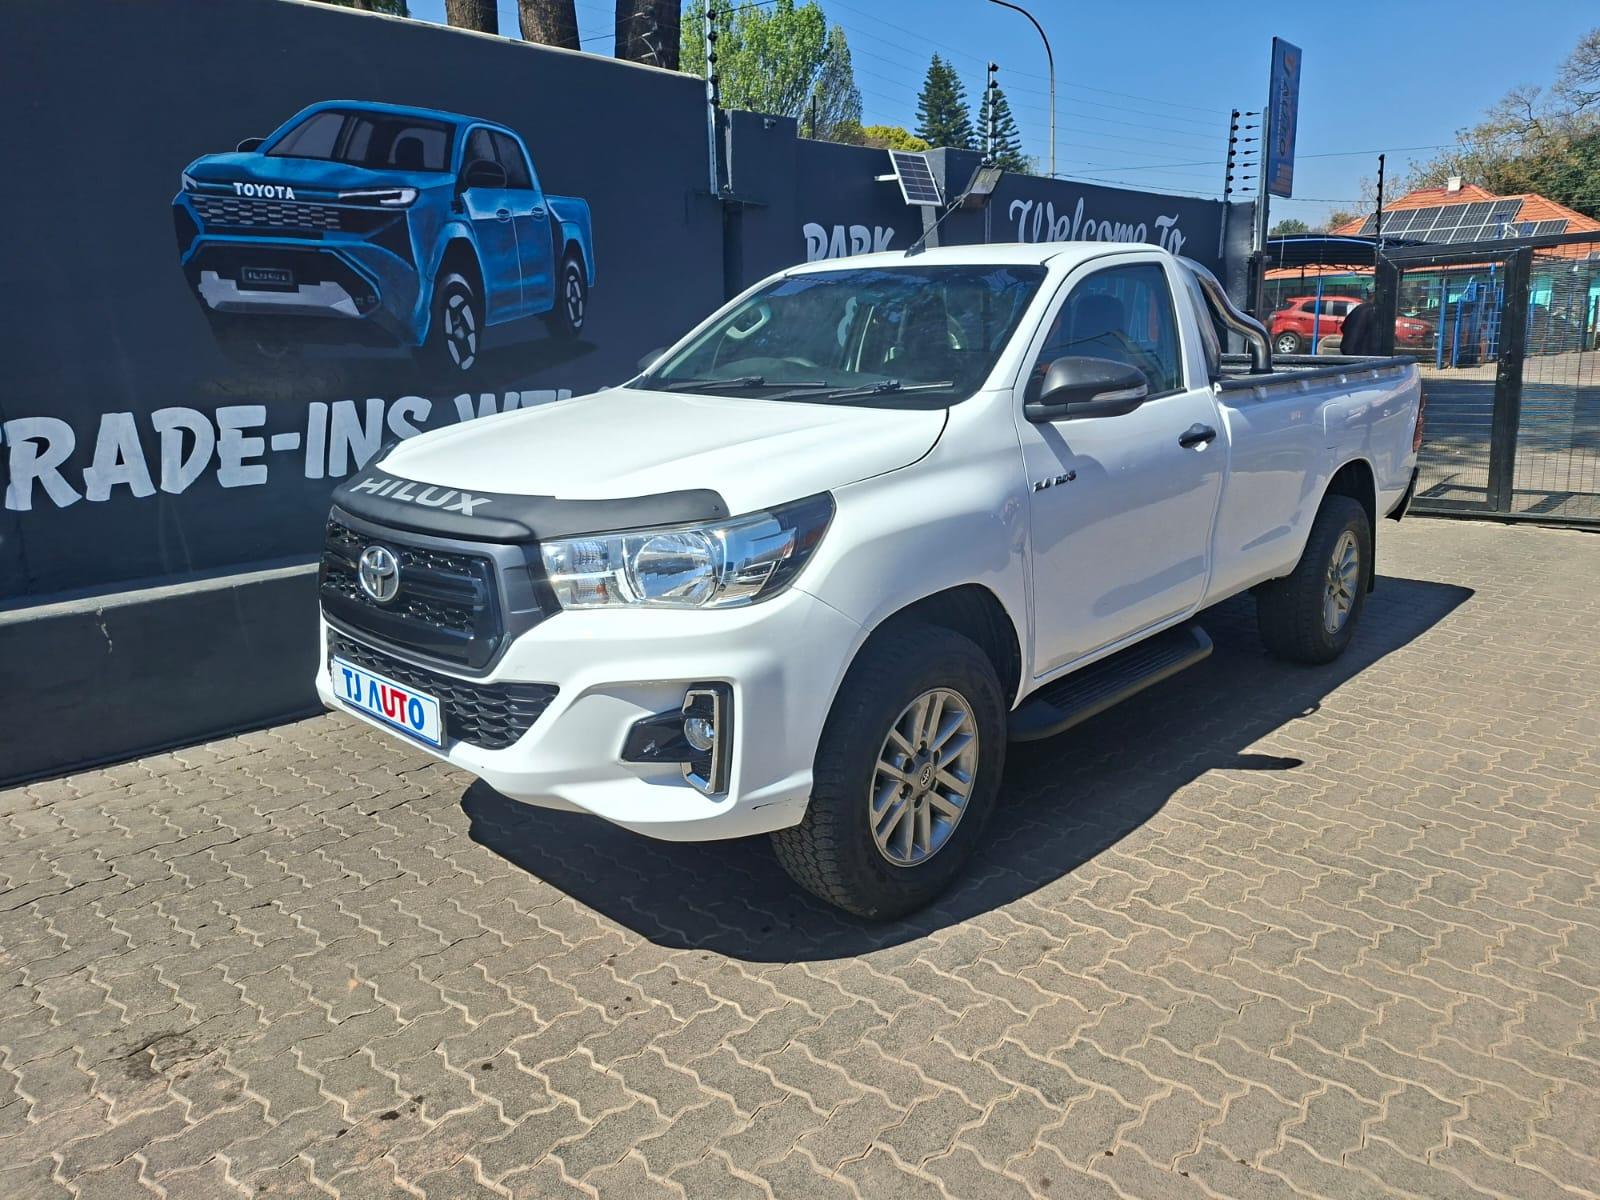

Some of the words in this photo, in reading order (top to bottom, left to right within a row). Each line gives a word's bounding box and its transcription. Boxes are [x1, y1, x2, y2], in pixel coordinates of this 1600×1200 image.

[233, 182, 295, 200] TOYOTA
[803, 222, 895, 263] PARK
[1009, 197, 1147, 243] Welcome
[1154, 213, 1187, 256] To
[0, 396, 433, 512] RADE-INS
[350, 477, 493, 517] HILUX
[342, 667, 362, 703] TJ
[369, 680, 425, 731] AUTO
